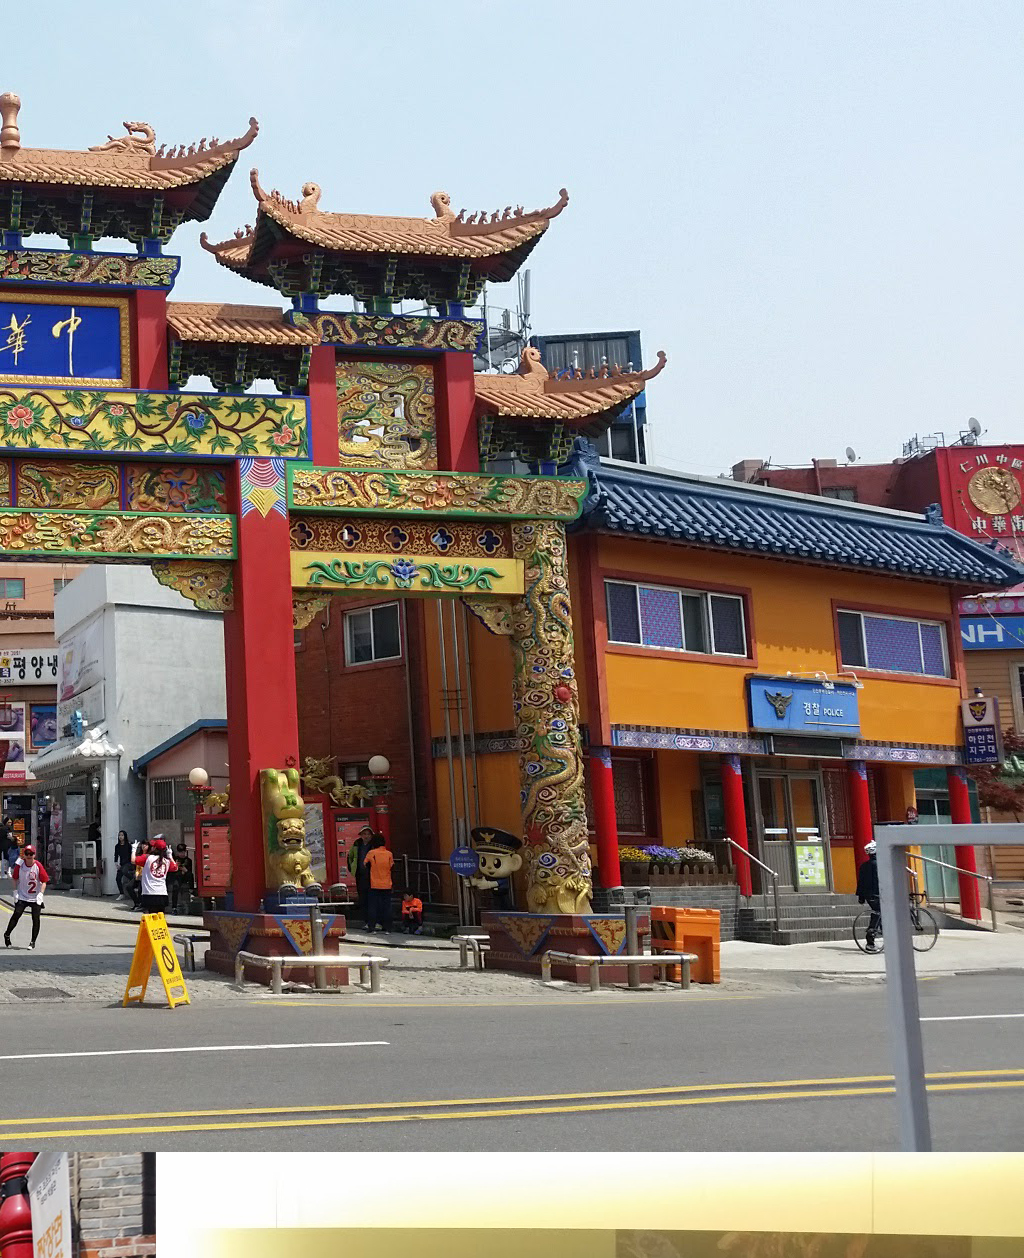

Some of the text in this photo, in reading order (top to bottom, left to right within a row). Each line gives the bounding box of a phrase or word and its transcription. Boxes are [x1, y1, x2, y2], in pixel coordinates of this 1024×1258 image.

[803, 701, 843, 717] 경찰 POLICE
[968, 735, 995, 744] 하인천
[969, 745, 996, 754] 지구대
[28, 881, 37, 894] 2
